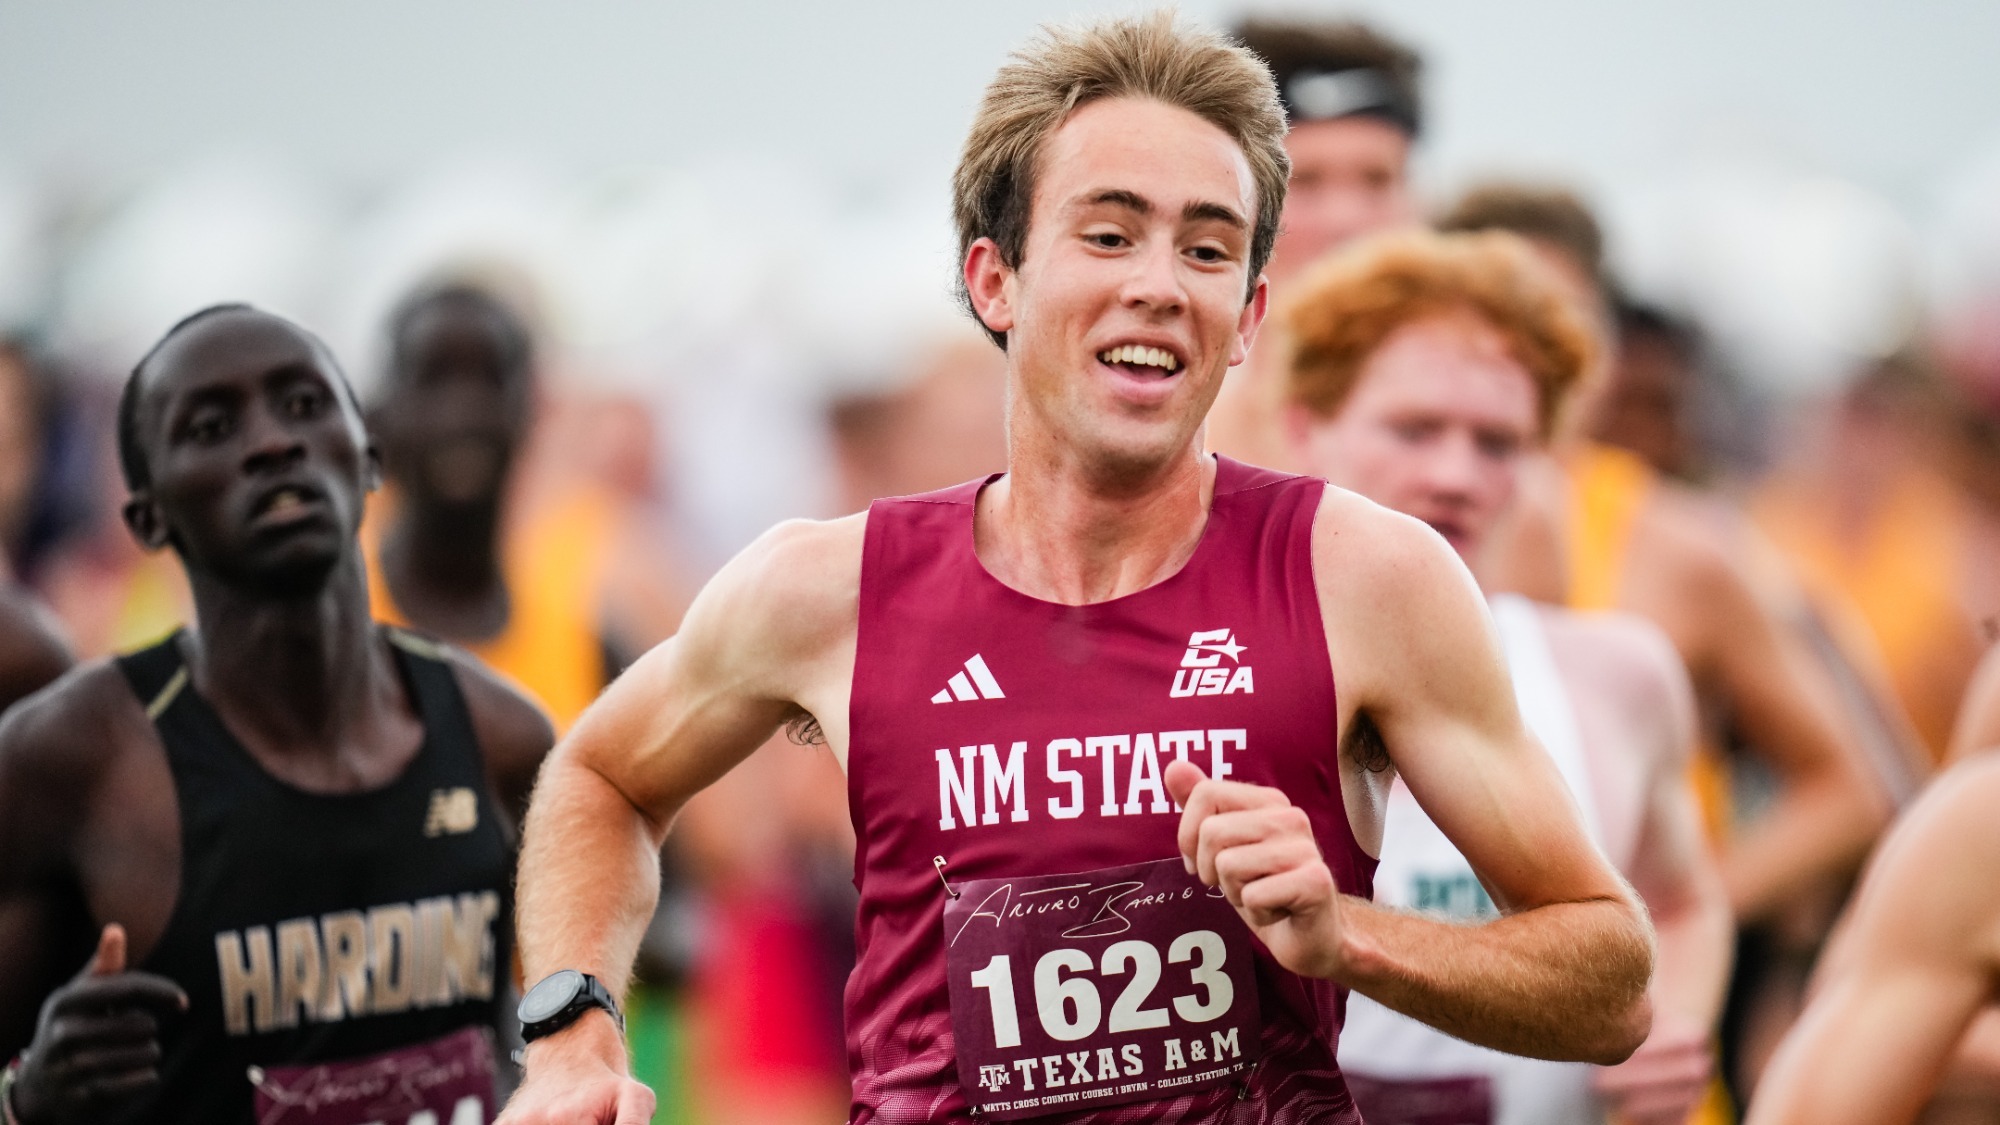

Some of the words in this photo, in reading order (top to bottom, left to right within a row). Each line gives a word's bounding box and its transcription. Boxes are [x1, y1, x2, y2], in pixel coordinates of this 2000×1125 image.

[1169, 666, 1254, 698] USA
[935, 741, 1030, 831] NM
[970, 929, 1235, 1049] 1623
[982, 1101, 1012, 1113] WATTS
[1013, 1098, 1040, 1110] CROSS
[1041, 1092, 1080, 1105] COUNTRY
[1081, 1087, 1114, 1100] COURSE
[1120, 1082, 1148, 1094] BRYAN
[1157, 1075, 1193, 1088] COLLEGE
[1232, 1062, 1244, 1072] TX
[1013, 1043, 1144, 1092] TEXAS
[1163, 1027, 1241, 1071] A&M
